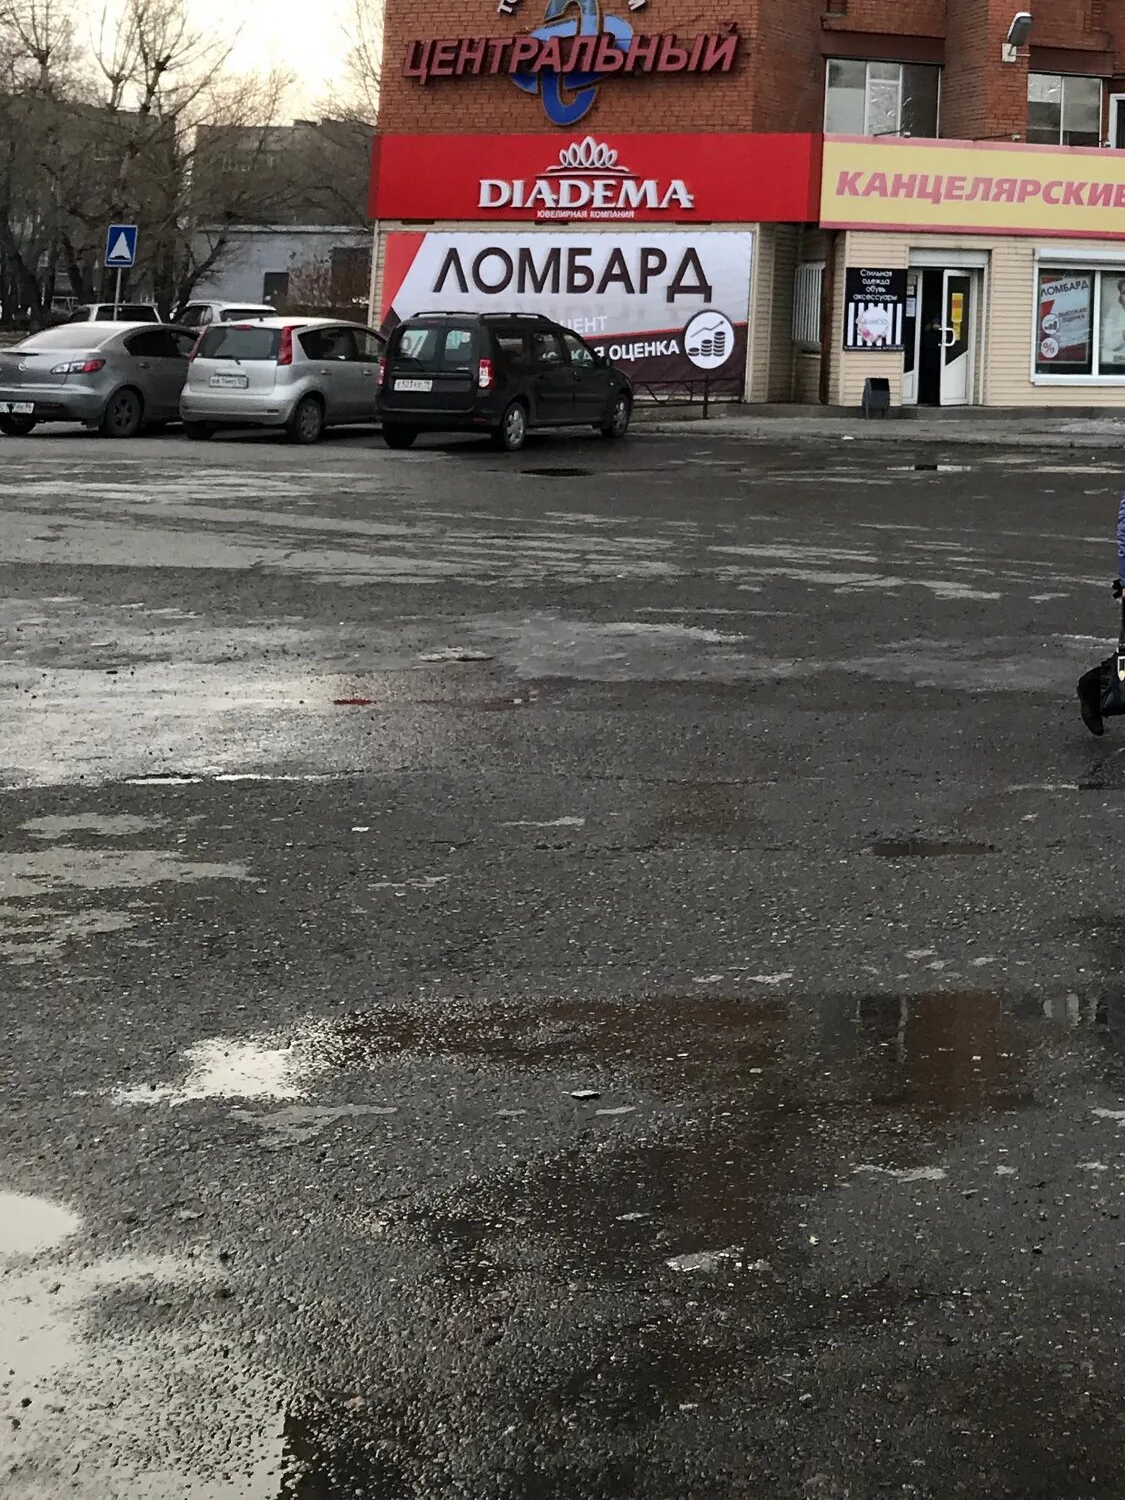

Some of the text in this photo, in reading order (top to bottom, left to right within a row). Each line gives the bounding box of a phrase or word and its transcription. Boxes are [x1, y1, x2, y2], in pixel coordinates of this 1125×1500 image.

[401, 20, 743, 85] ЦЕНТРАЛЬНЫЙ
[478, 179, 695, 209] DIADEMA
[537, 210, 635, 218] ЮВЕЛИРНАЯ КОМПАНИЯ
[433, 247, 712, 303] ЛОМБАРД
[860, 269, 892, 277] Стильная
[865, 285, 886, 293] обувь
[1040, 280, 1089, 297] ЛОМБАРД
[560, 315, 608, 334] ЦЕНТ
[609, 339, 680, 362] ОЦЕНКА
